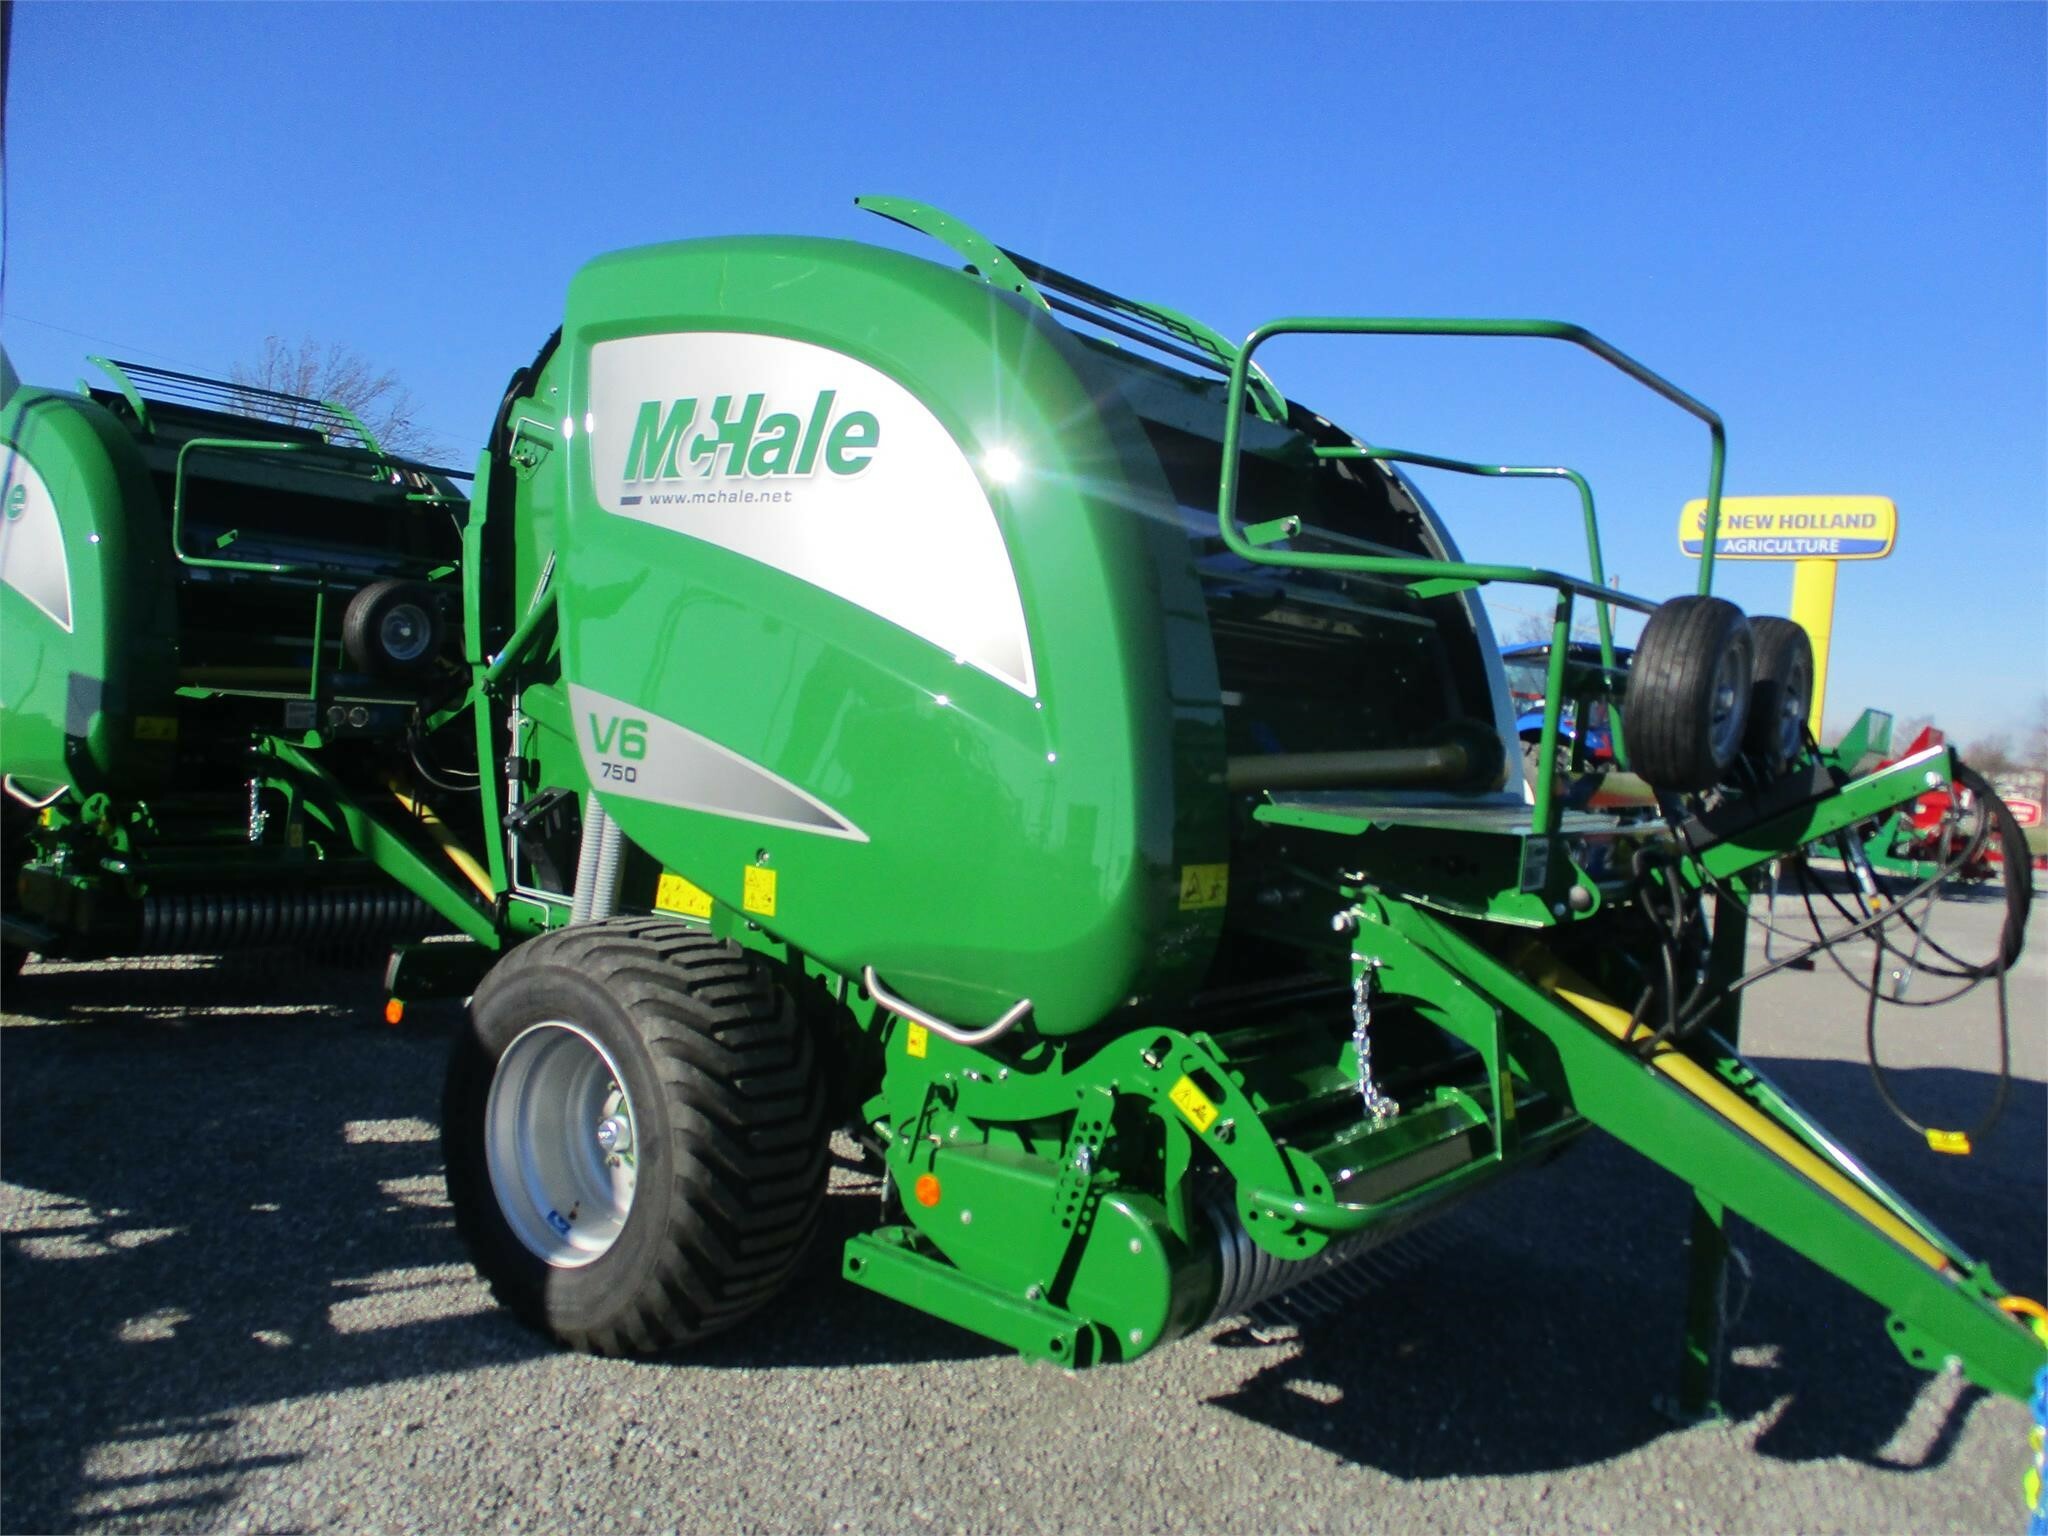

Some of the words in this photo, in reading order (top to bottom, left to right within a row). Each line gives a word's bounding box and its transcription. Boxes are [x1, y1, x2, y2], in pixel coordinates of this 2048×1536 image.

[622, 389, 881, 483] McHale
[650, 490, 793, 505] www.mchale.net
[1728, 515, 1774, 530] NEW
[1779, 513, 1876, 530] HOLLAND
[1723, 539, 1840, 553] AGRICULTURE
[589, 712, 648, 760] V6
[601, 762, 637, 783] 750
